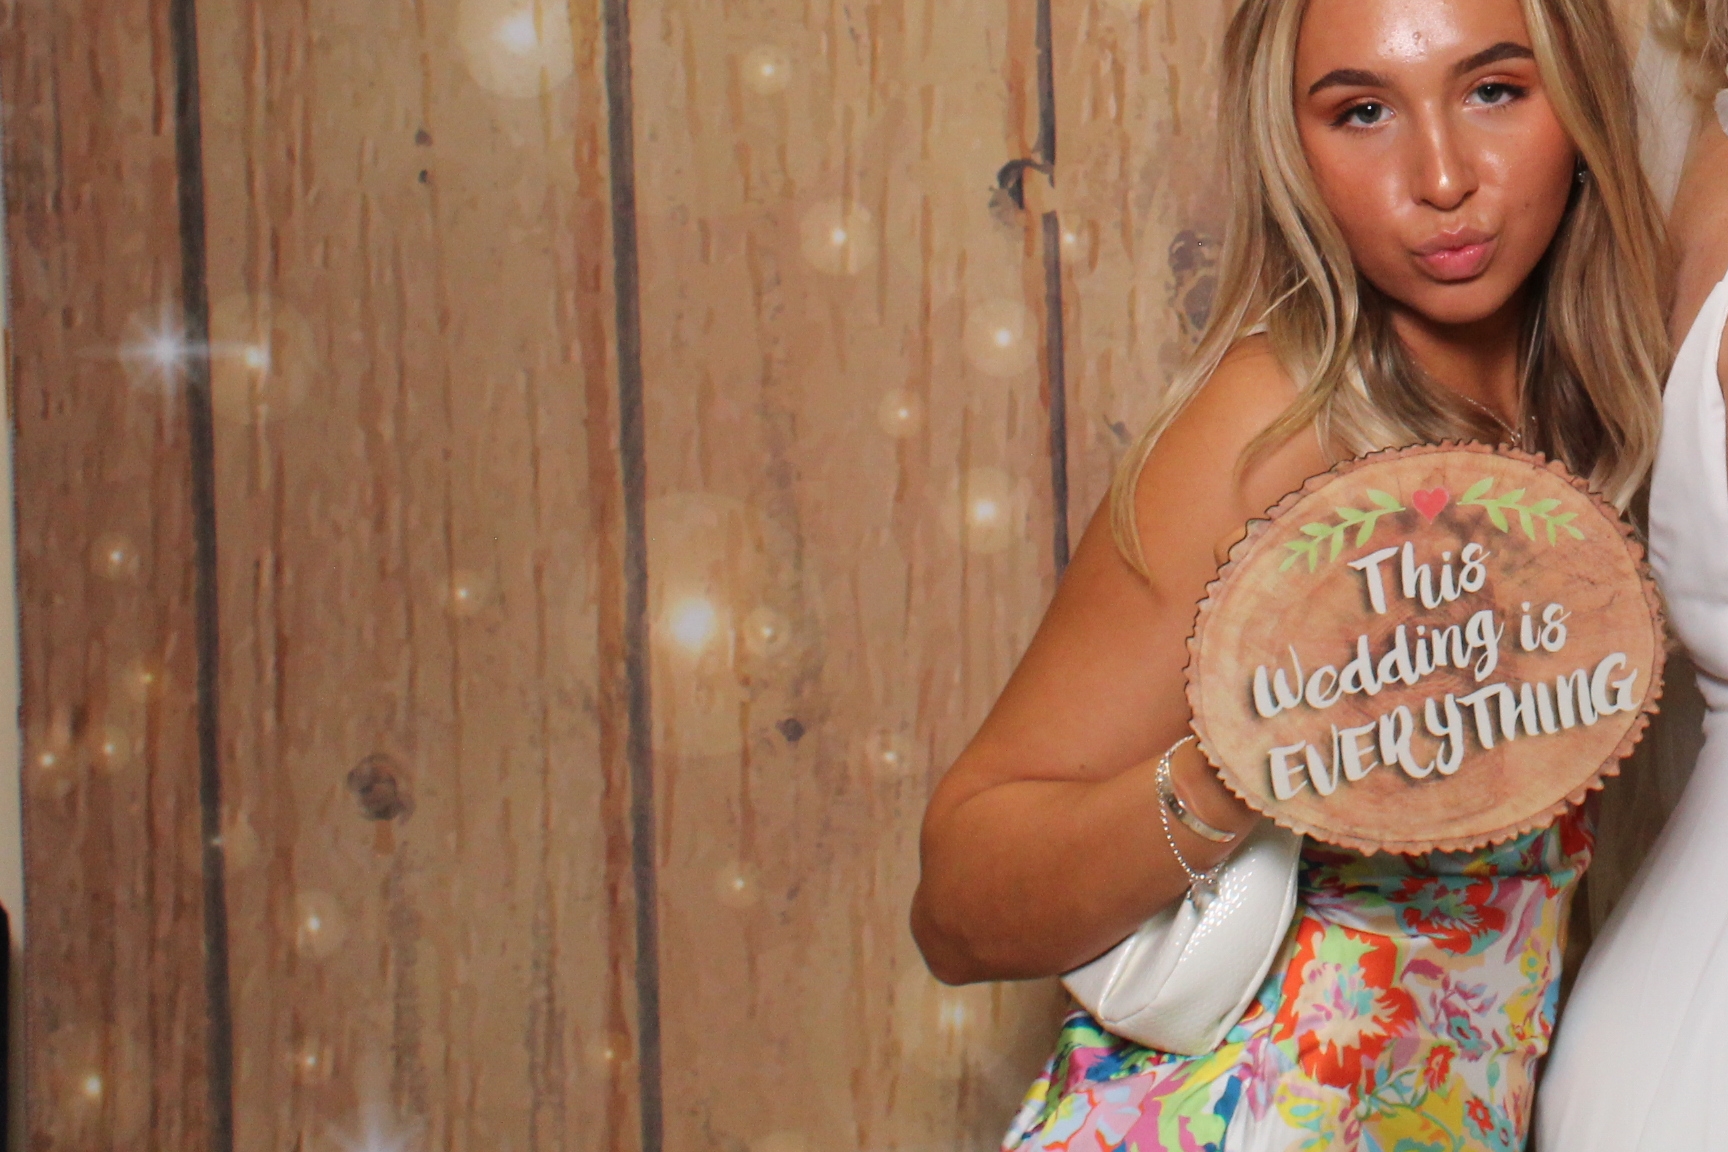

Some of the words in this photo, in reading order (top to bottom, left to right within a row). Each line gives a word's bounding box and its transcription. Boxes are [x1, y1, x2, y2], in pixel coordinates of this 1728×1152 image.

[1347, 541, 1490, 614] This
[1253, 609, 1504, 719] Wedding
[1520, 601, 1572, 652] is
[1267, 652, 1643, 800] EVERYTHING
